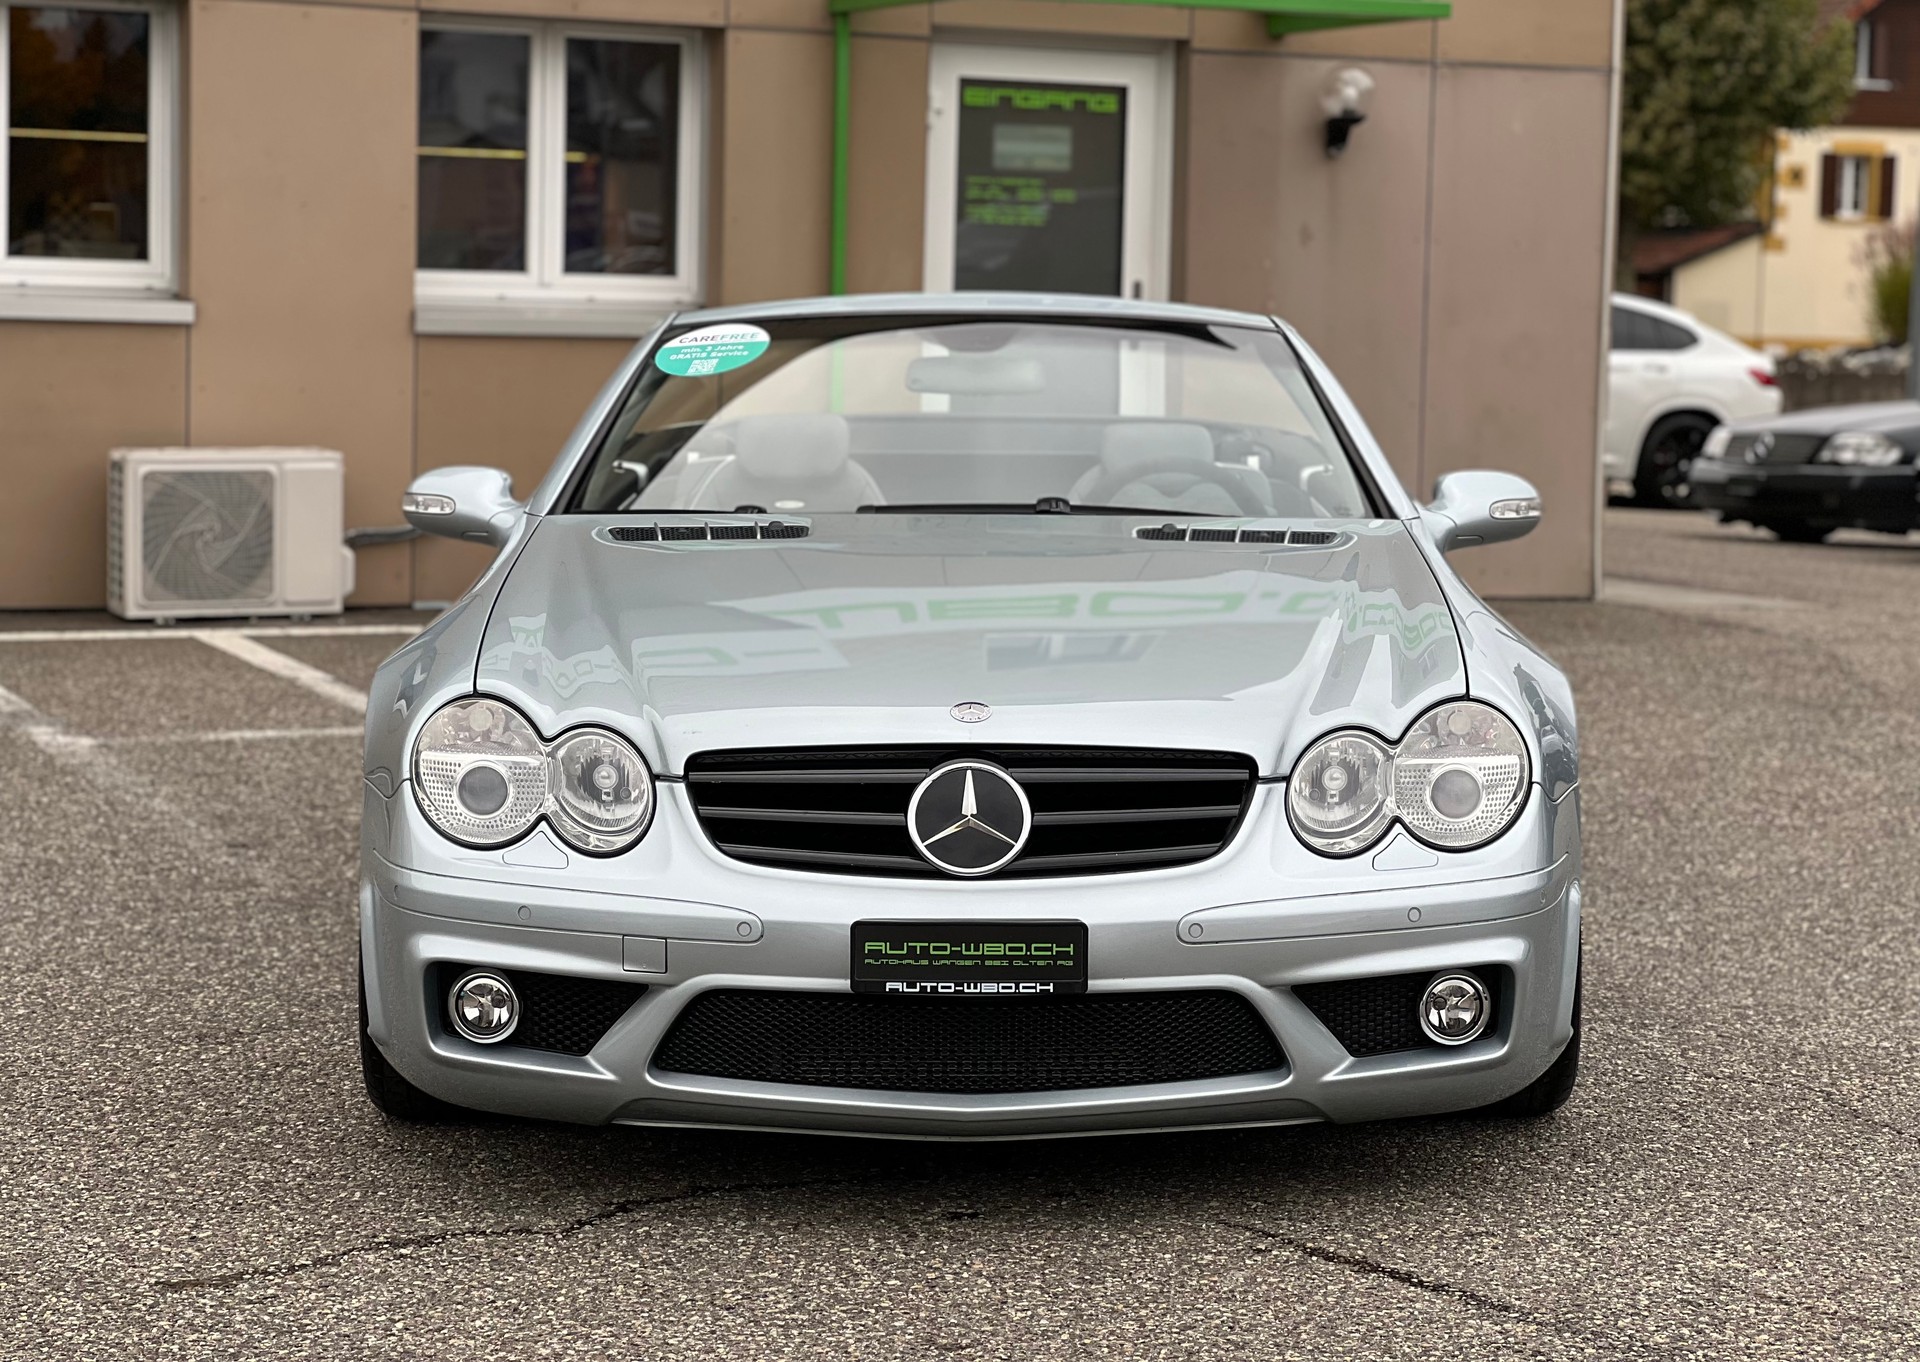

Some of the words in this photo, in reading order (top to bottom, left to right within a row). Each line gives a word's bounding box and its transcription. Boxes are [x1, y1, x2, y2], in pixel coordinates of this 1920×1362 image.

[679, 332, 760, 344] CAREFREE
[669, 352, 708, 360] GRATIS
[864, 941, 1074, 956] AUTO-WBO.CH
[885, 982, 1054, 993] AUTO-WBO.CH
